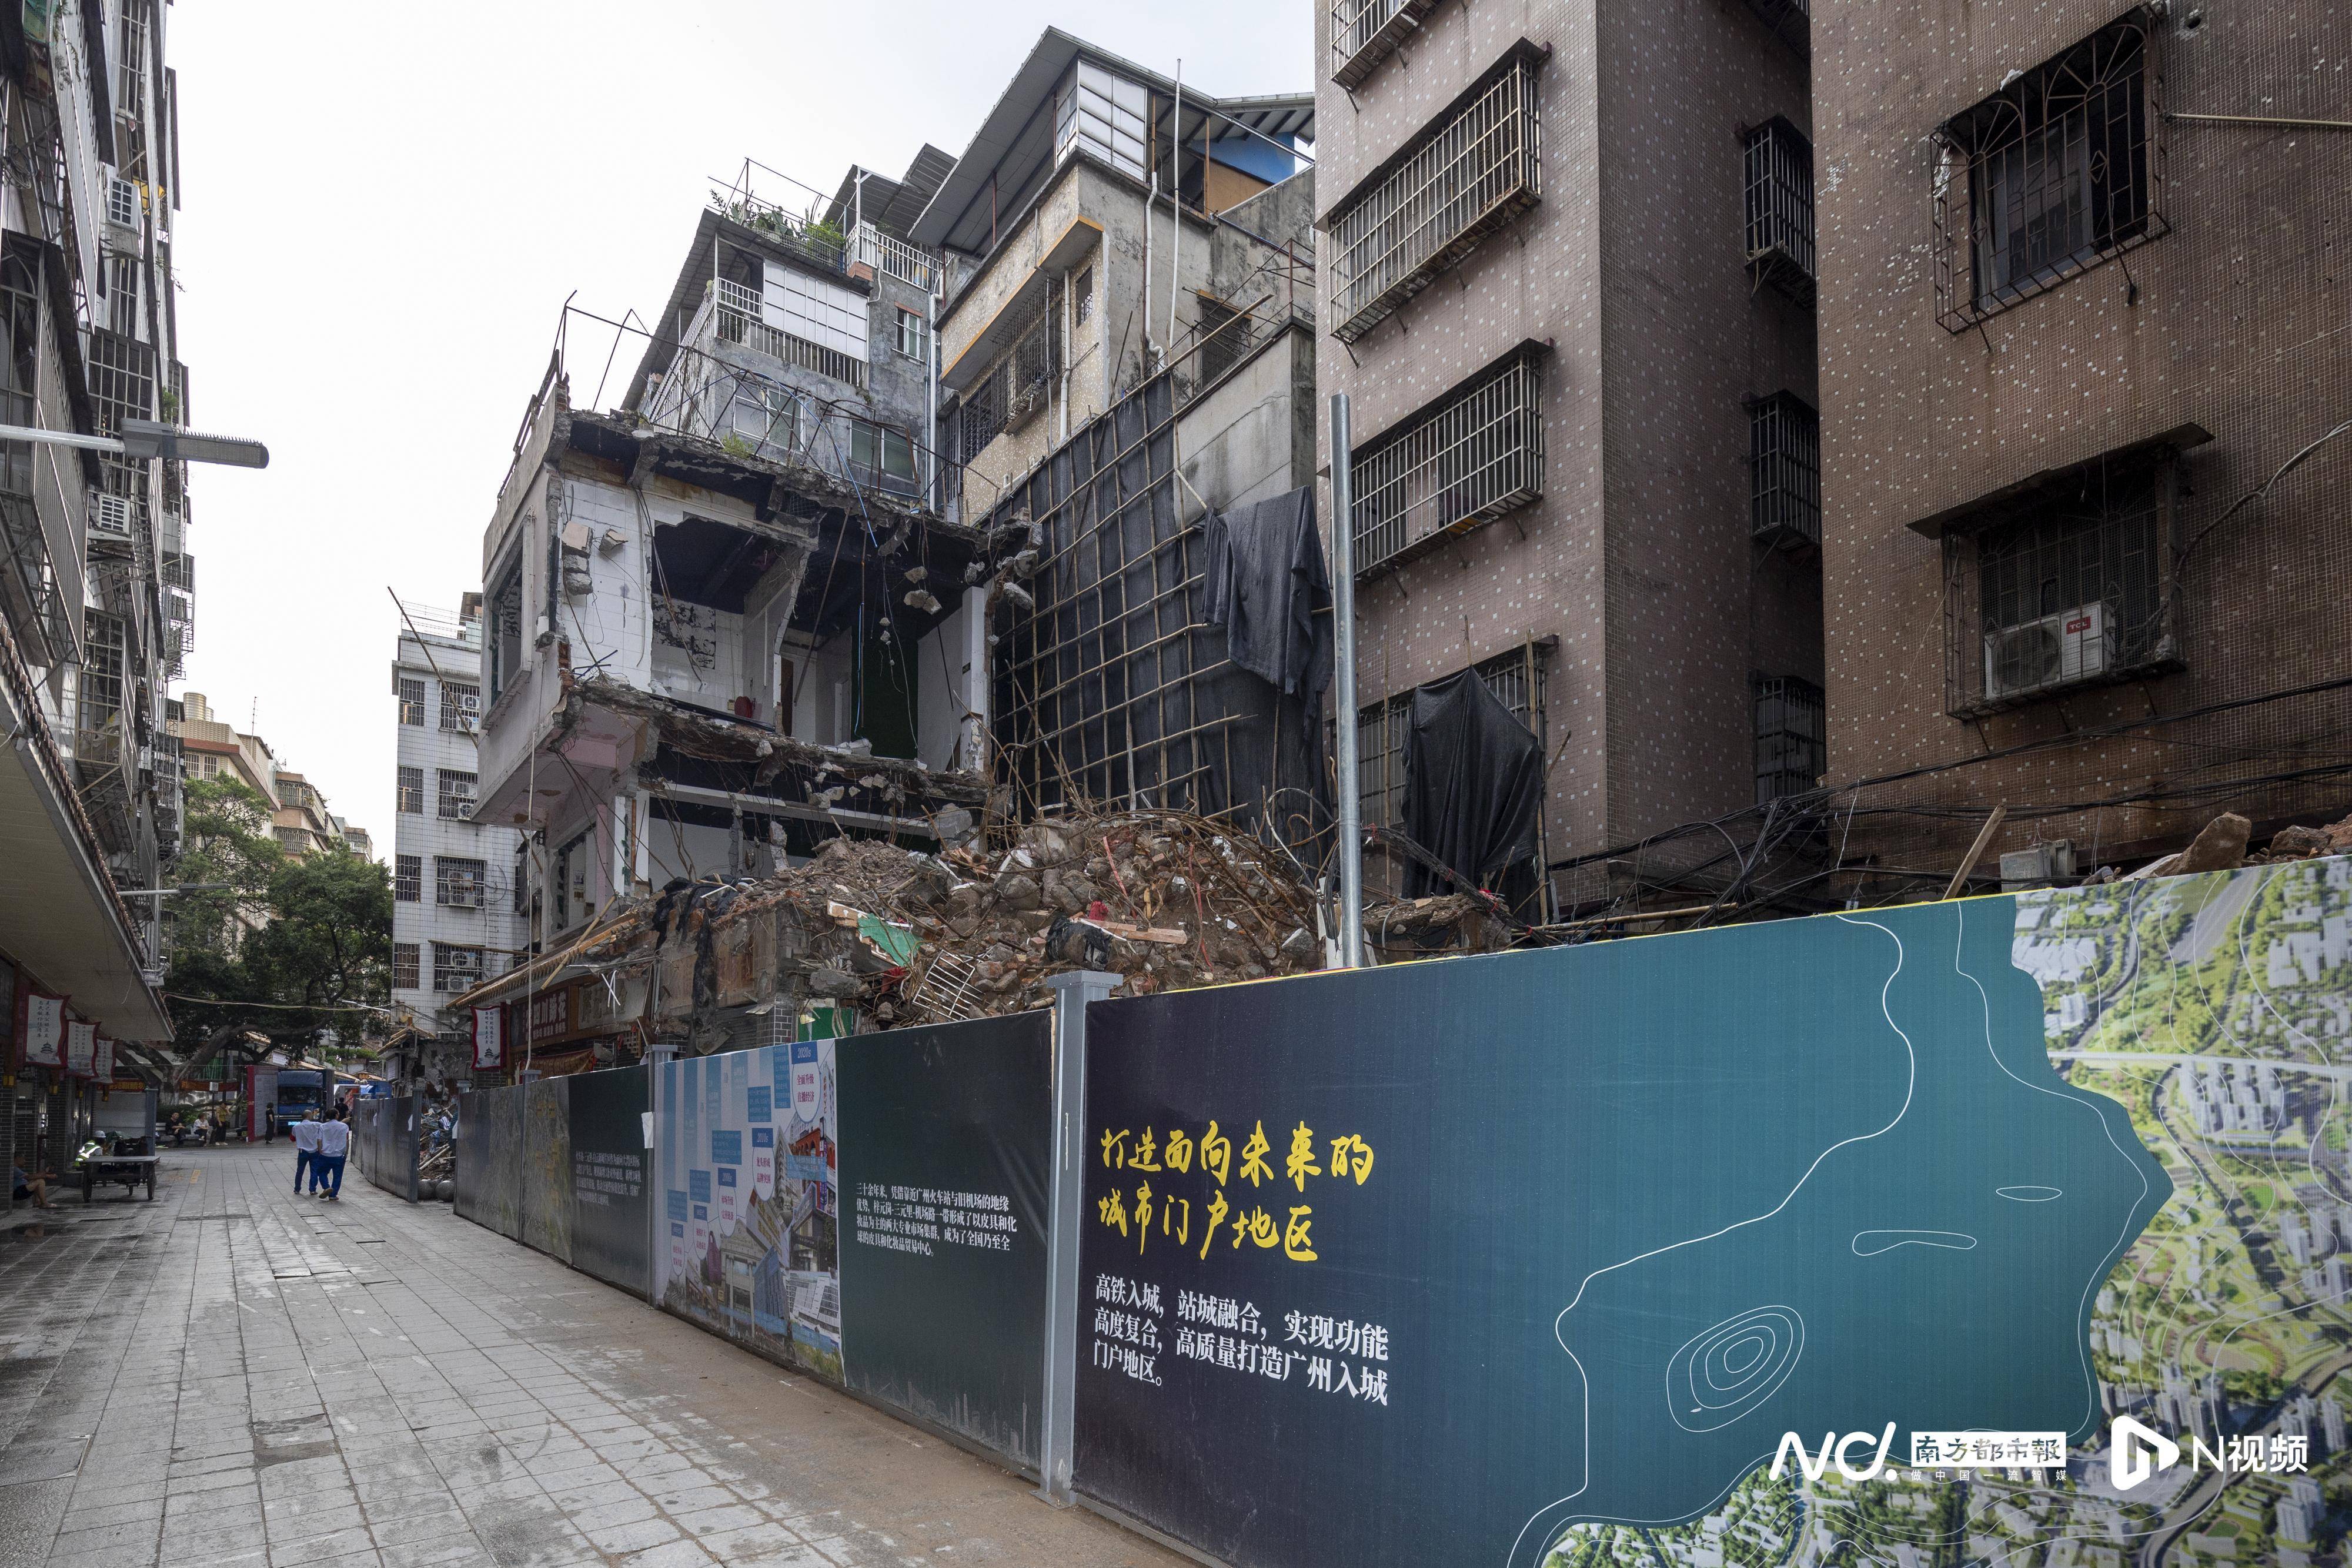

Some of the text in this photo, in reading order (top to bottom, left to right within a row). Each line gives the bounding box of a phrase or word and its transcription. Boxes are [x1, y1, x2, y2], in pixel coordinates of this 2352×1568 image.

[2069, 621, 2087, 630] TCL
[797, 1047, 811, 1058] 2020s
[797, 1073, 814, 1086] 全面升级
[797, 1091, 815, 1103] 直播经济
[757, 1132, 769, 1143] 2010s
[1100, 1119, 1374, 1193] 打造面向未来的
[1098, 1179, 1318, 1262] 城市门户地区
[1094, 1339, 1162, 1387] 门户地区。
